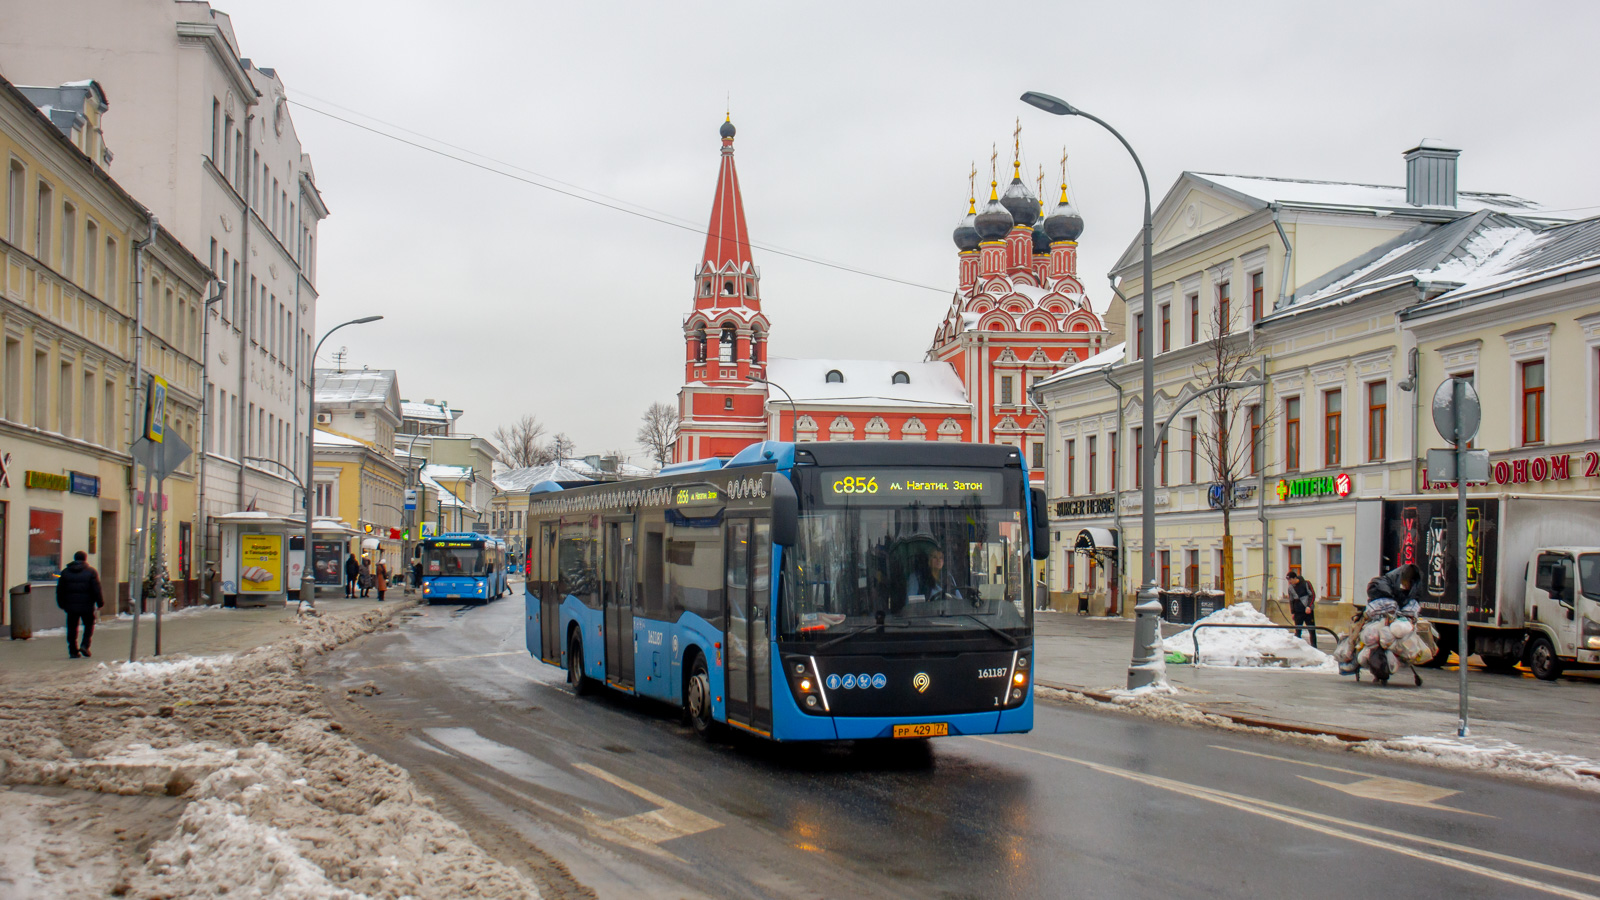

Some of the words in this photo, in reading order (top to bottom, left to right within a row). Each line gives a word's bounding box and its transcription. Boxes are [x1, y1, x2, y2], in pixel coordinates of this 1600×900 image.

[1584, 451, 1600, 478] 2
[833, 476, 878, 494] с856
[890, 482, 903, 490] м.
[906, 480, 949, 491] Нагатин.
[953, 480, 983, 490] Затон
[1288, 476, 1335, 498] АПТЕКА
[1056, 499, 1085, 517] BURGER
[1086, 497, 1116, 515] HEROE
[1404, 518, 1415, 565] VAS
[1465, 518, 1476, 579] VAST
[1433, 528, 1443, 587] VAST
[978, 667, 1008, 679] 161187
[993, 696, 999, 706] 1
[913, 725, 931, 735] 429
[935, 723, 945, 732] 77
